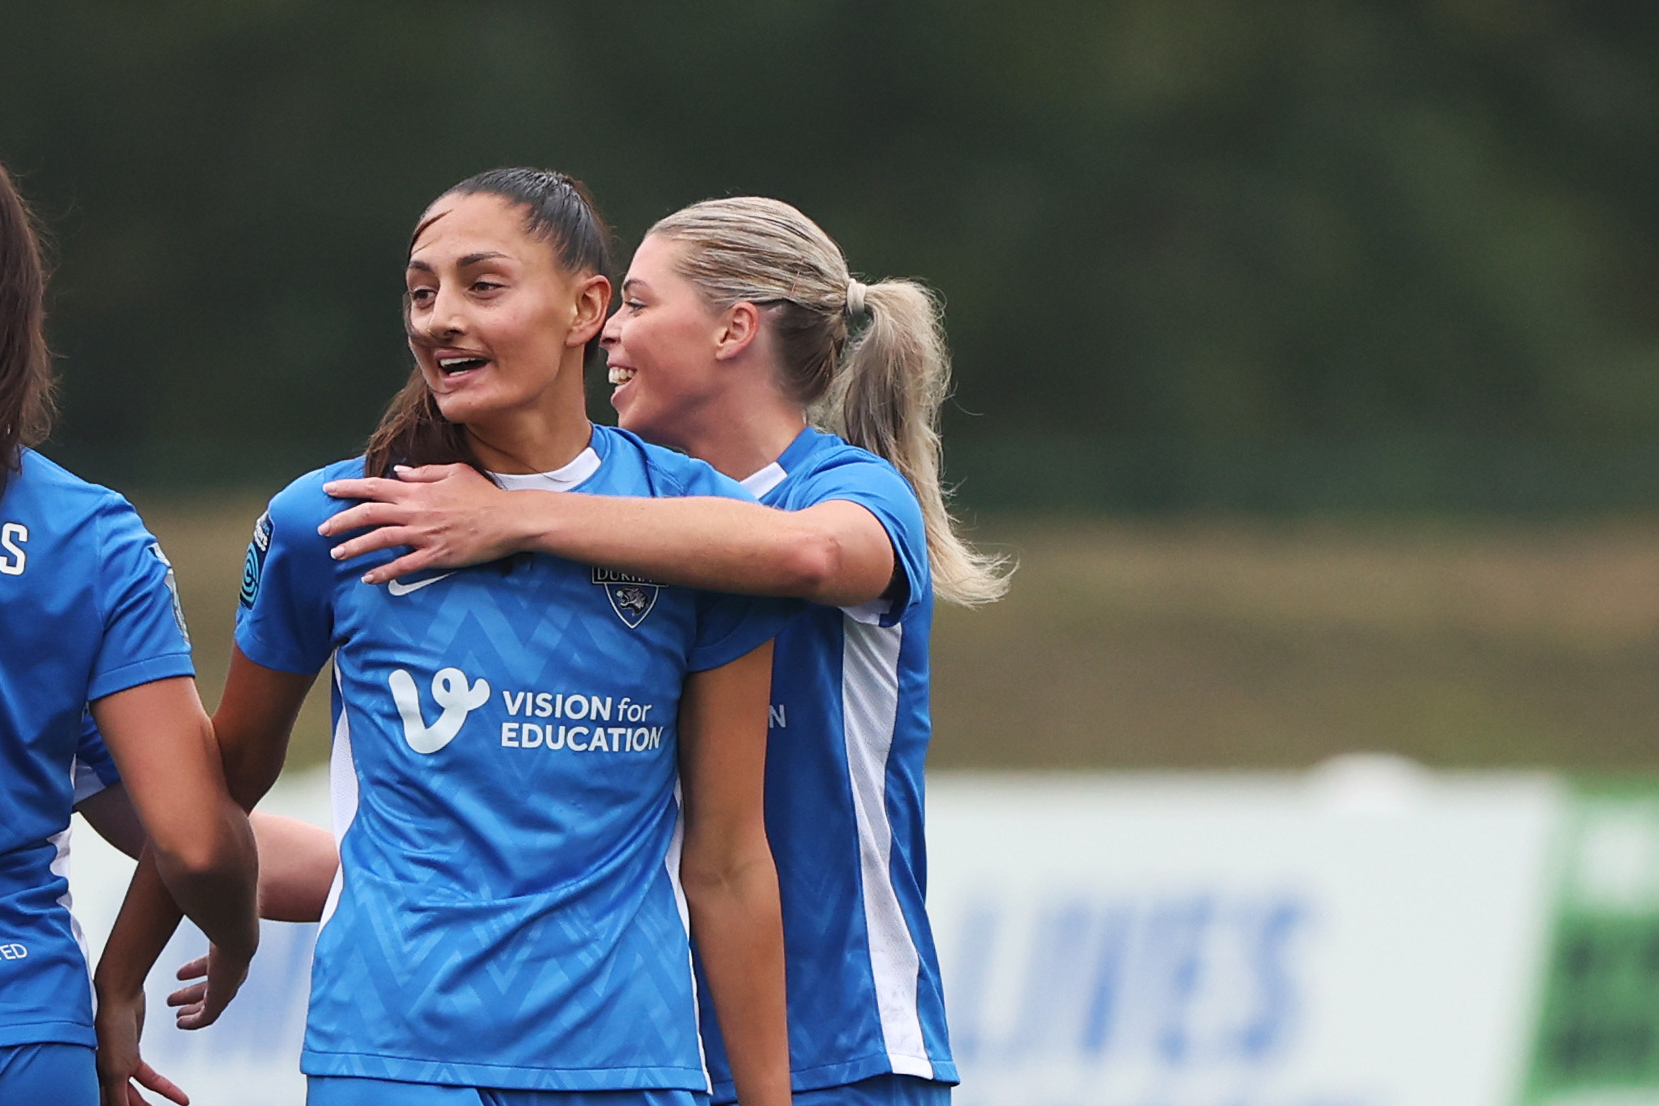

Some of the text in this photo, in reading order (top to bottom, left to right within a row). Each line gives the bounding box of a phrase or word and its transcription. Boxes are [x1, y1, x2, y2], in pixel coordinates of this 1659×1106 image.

[502, 690, 653, 723] VISION for
[501, 721, 665, 752] EDUCATION
